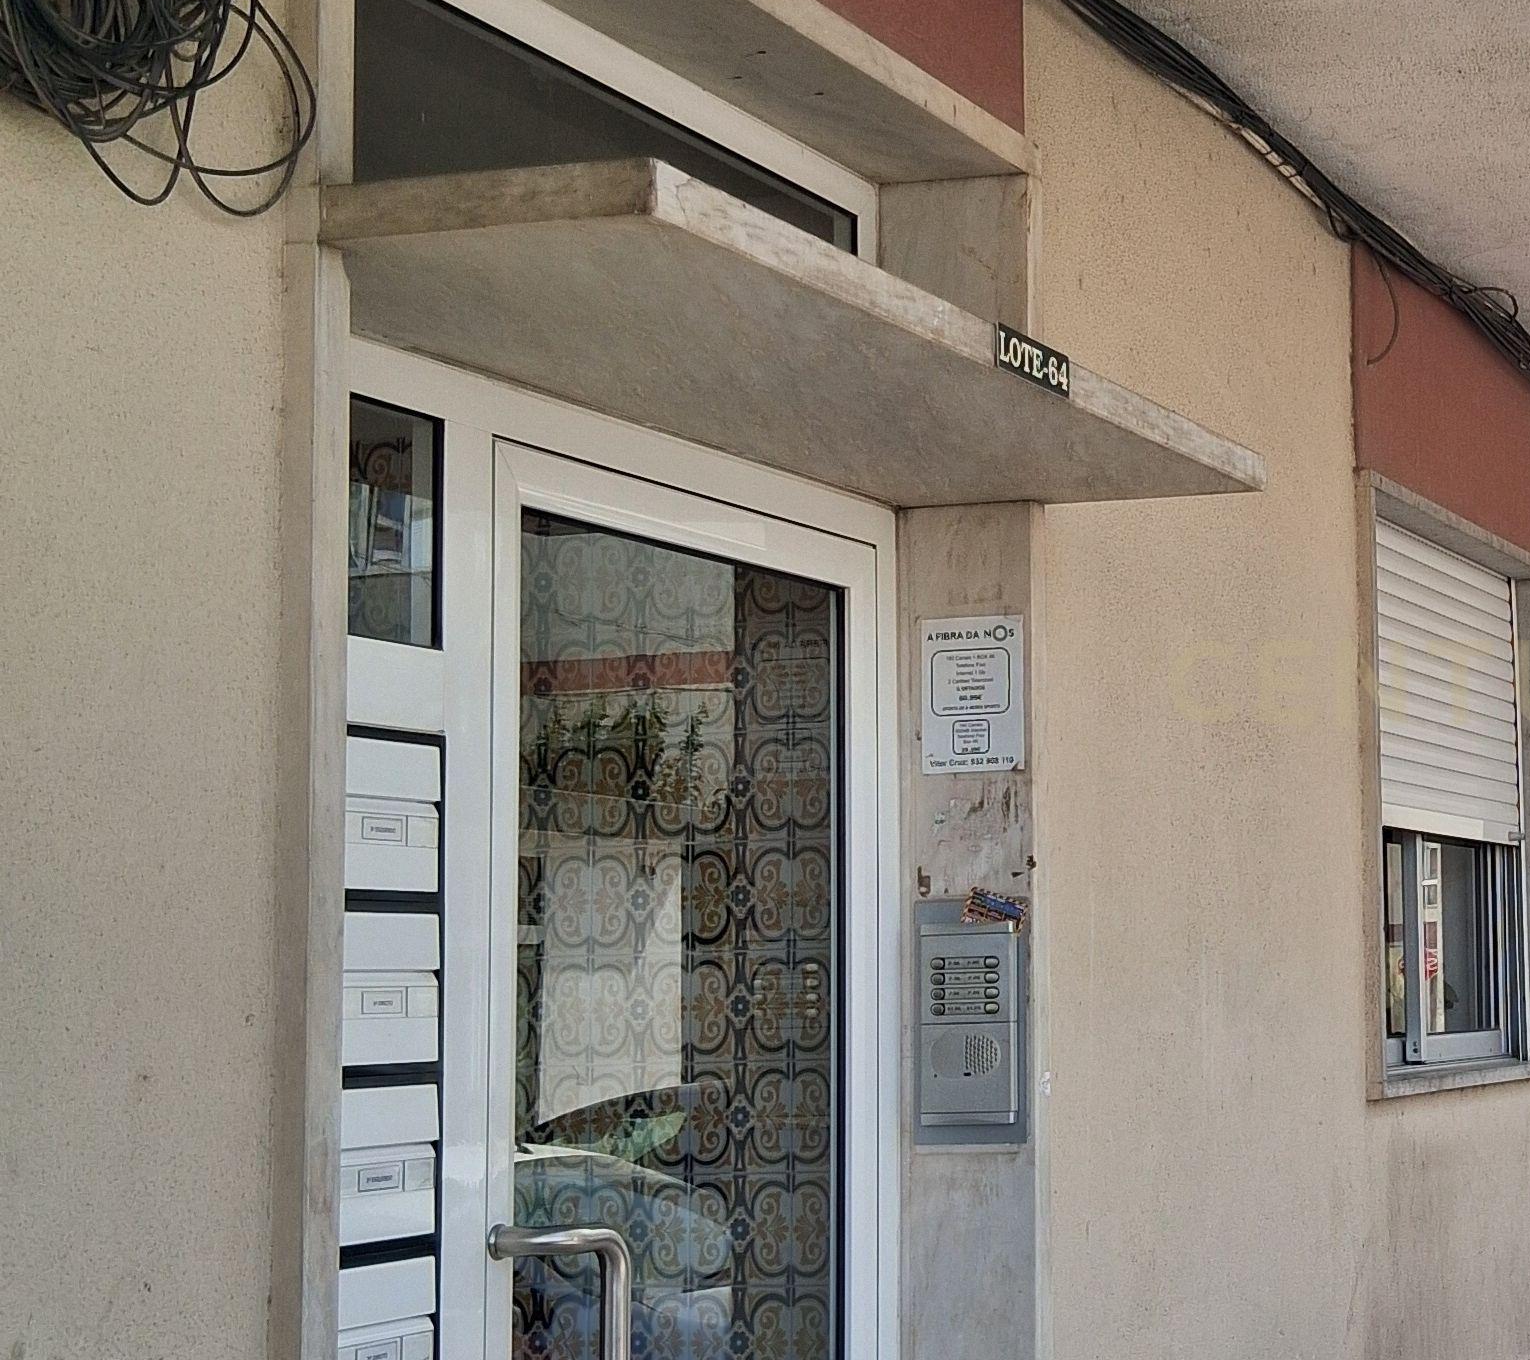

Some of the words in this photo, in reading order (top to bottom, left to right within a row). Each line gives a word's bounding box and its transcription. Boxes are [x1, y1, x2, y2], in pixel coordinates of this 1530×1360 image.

[998, 330, 1069, 391] LOTE-64
[926, 633, 934, 642] A
[935, 630, 964, 641] FIBRA
[966, 630, 980, 640] DA
